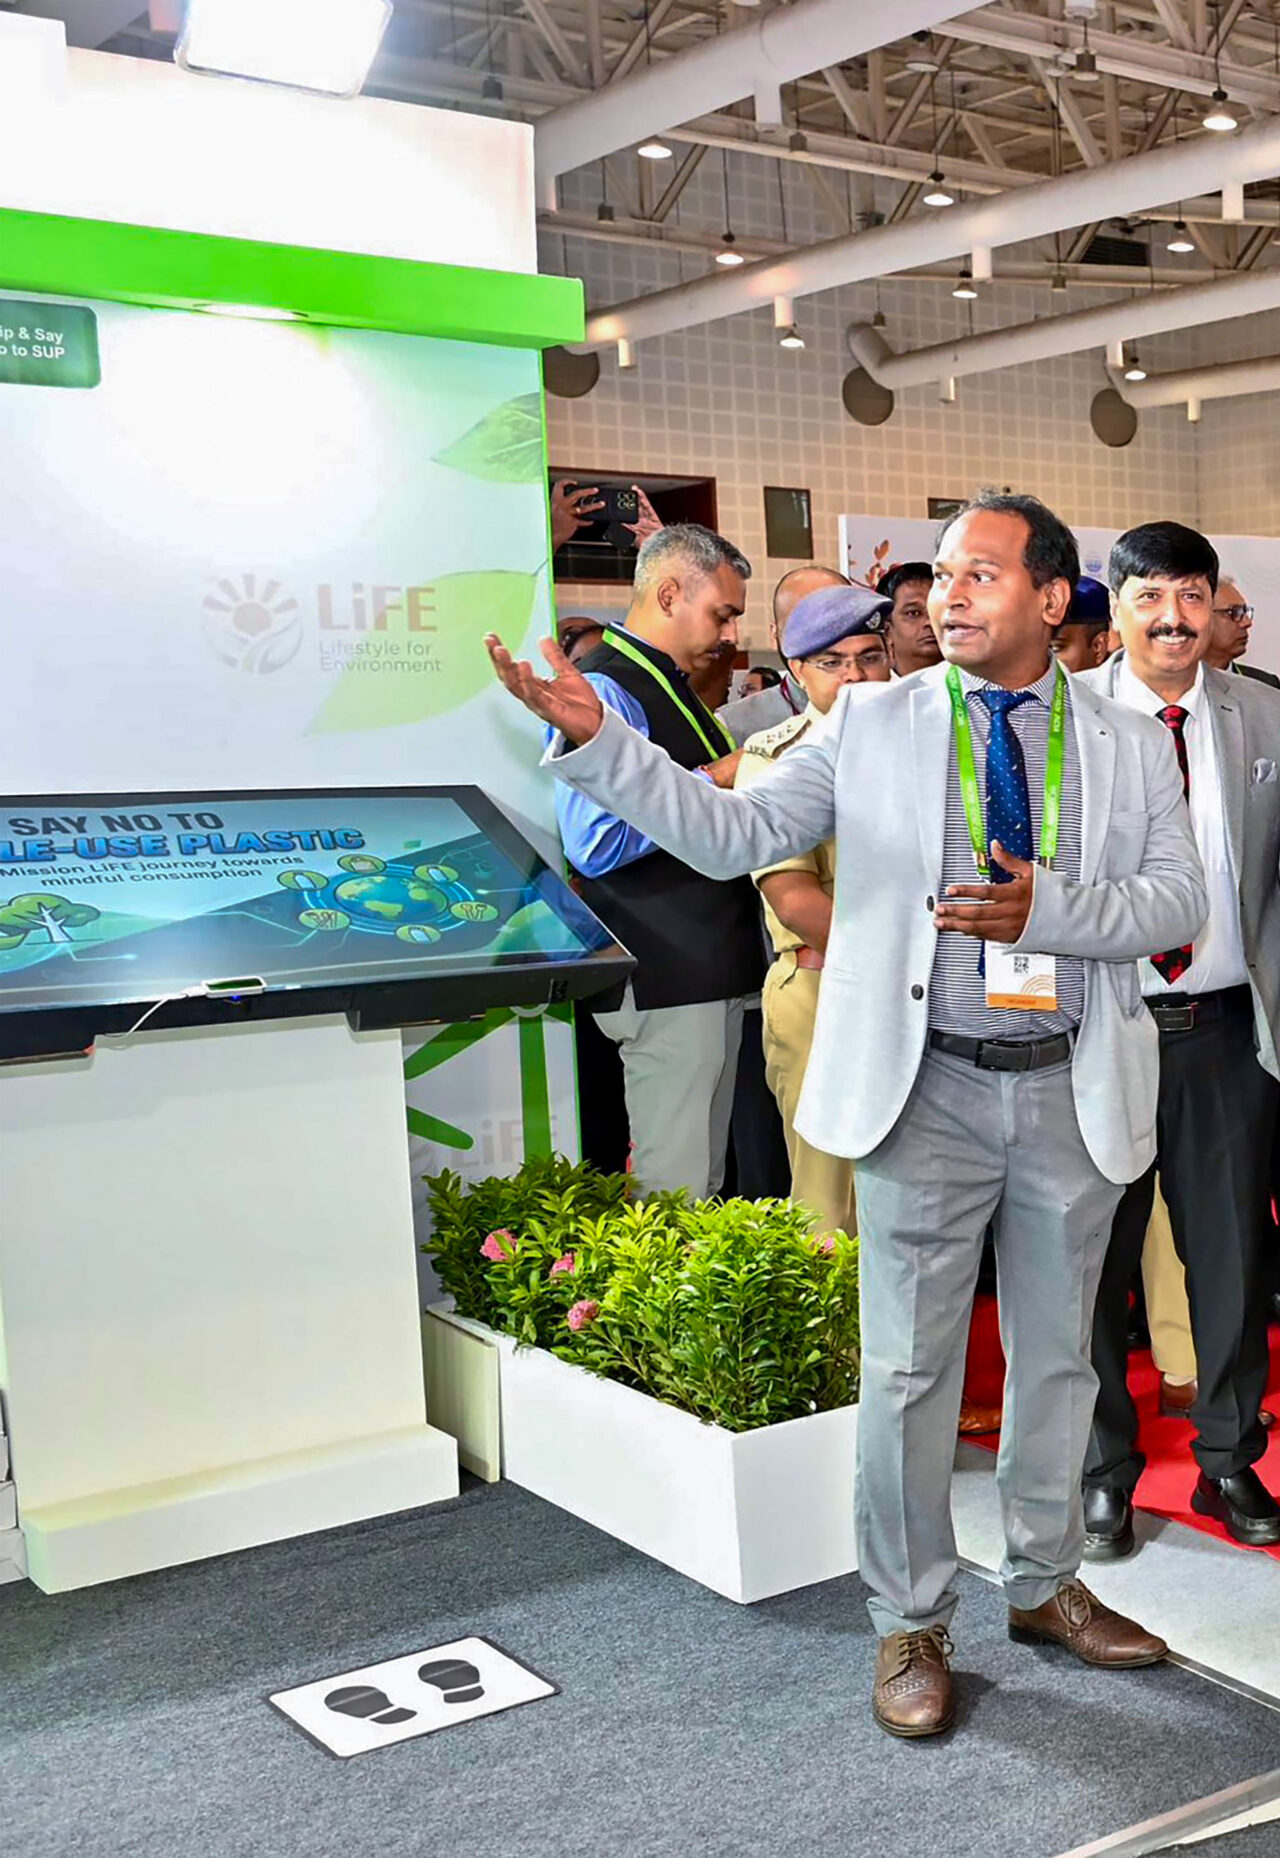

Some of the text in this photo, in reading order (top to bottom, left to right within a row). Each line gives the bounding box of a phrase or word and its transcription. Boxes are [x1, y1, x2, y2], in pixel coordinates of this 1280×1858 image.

[18, 327, 30, 340] &
[34, 328, 64, 345] Say
[12, 344, 28, 357] to
[32, 345, 65, 359] SUP
[317, 582, 438, 632] LiFE
[320, 640, 432, 657] Lifestyle for
[320, 657, 442, 672] Environment
[8, 811, 224, 836] SAY NO TO
[177, 827, 366, 856] PLASTIC
[0, 854, 305, 878] Mission LiFE journey towards
[41, 867, 263, 887] mindful consumption
